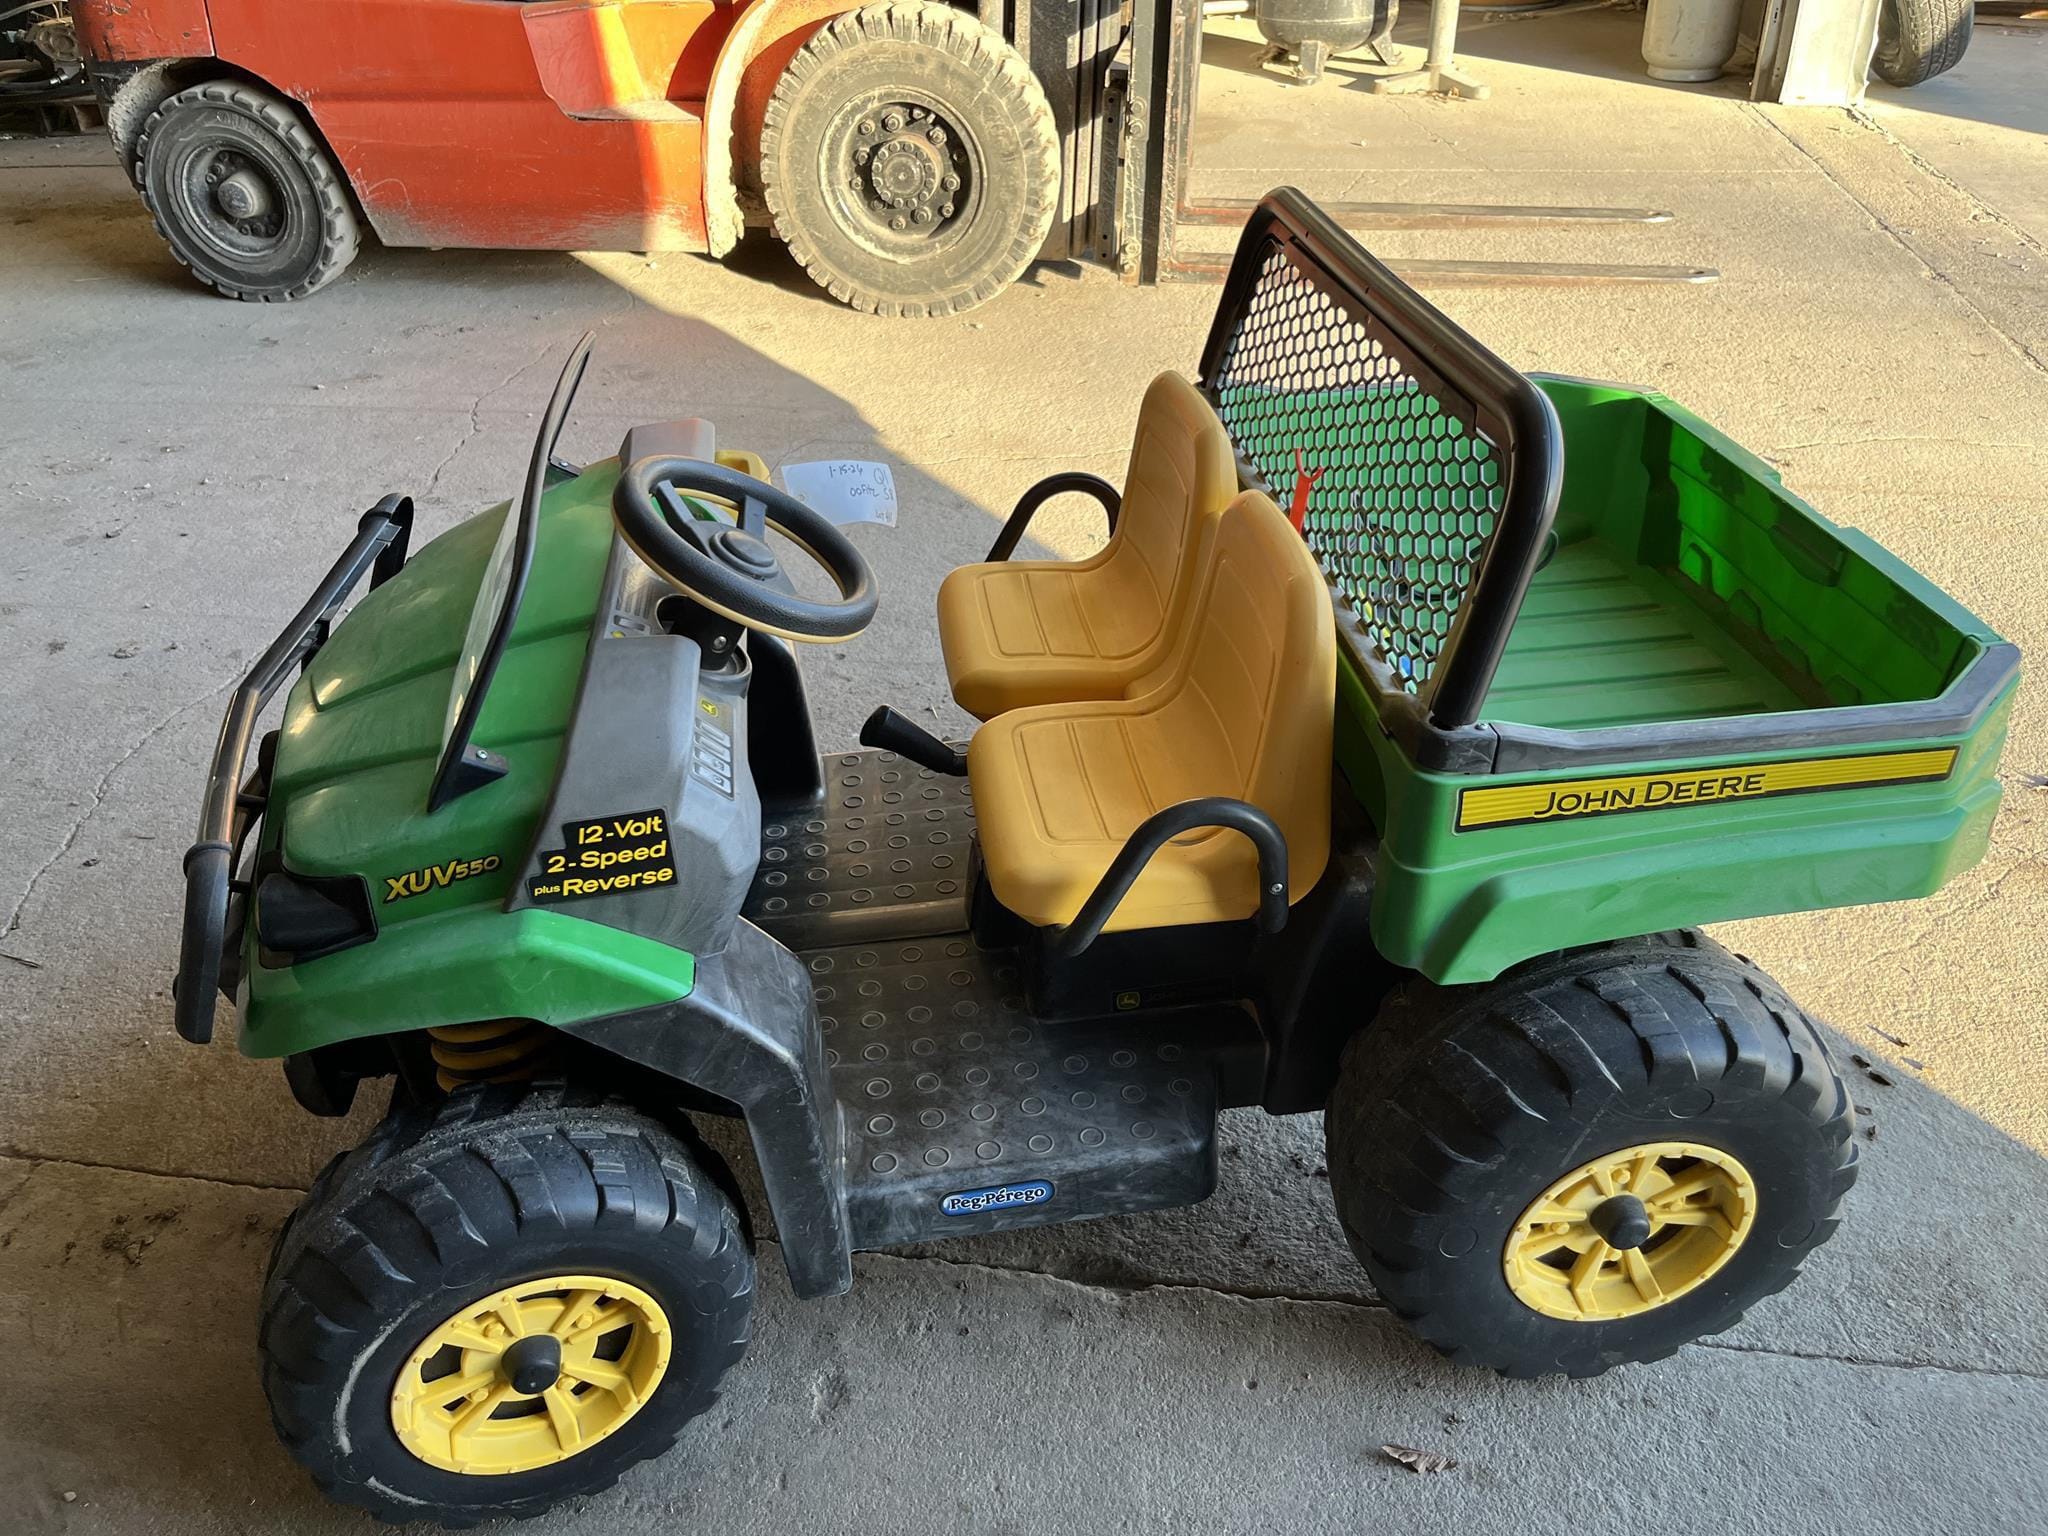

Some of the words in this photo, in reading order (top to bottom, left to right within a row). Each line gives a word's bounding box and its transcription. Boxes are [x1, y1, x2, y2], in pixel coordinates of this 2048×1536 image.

[1534, 788, 1635, 817] JOHN
[1646, 773, 1767, 807] DEERE
[578, 815, 664, 845] 12-Volt
[547, 840, 667, 874] 2-Speed
[534, 883, 561, 897] plus
[562, 867, 674, 897] Reverse
